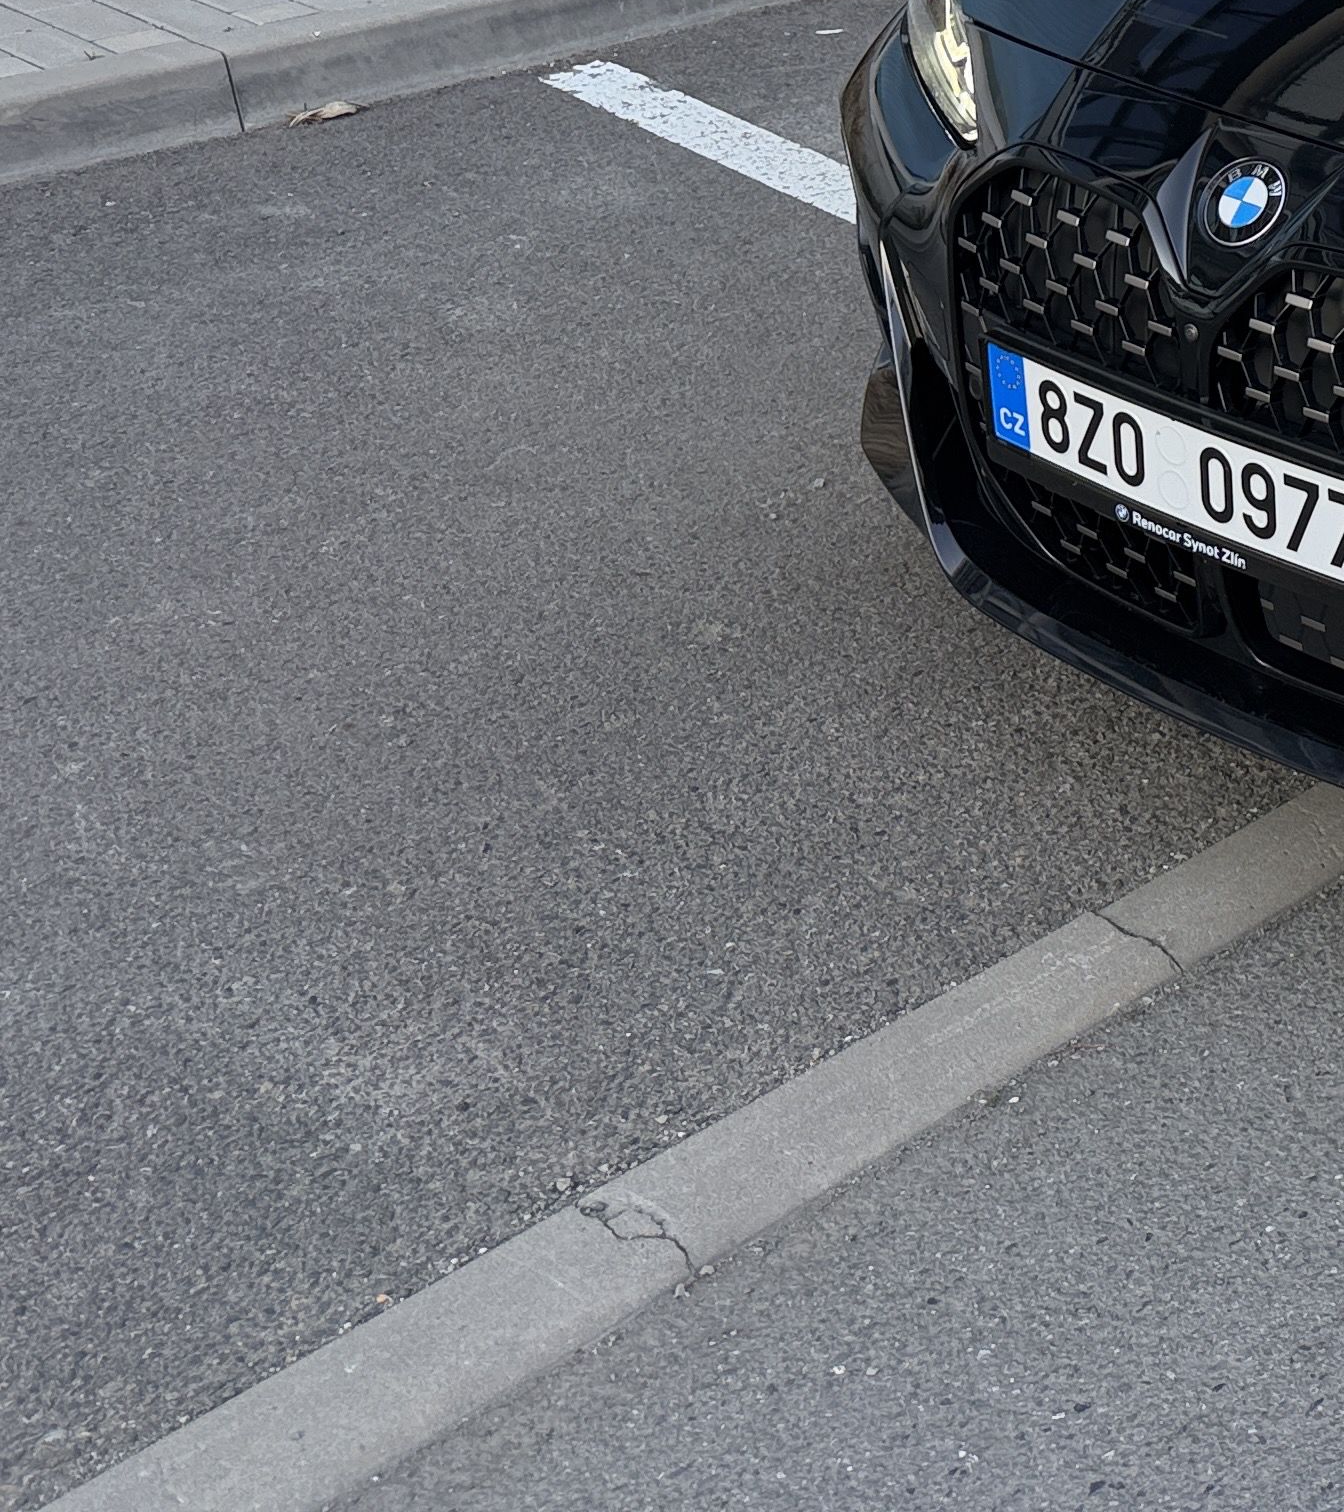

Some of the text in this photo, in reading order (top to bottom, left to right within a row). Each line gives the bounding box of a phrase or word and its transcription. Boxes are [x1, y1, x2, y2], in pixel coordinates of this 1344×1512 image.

[1228, 164, 1282, 197] BMW
[999, 407, 1026, 436] CZ
[1132, 510, 1247, 570] Renocar Synot Zlín
